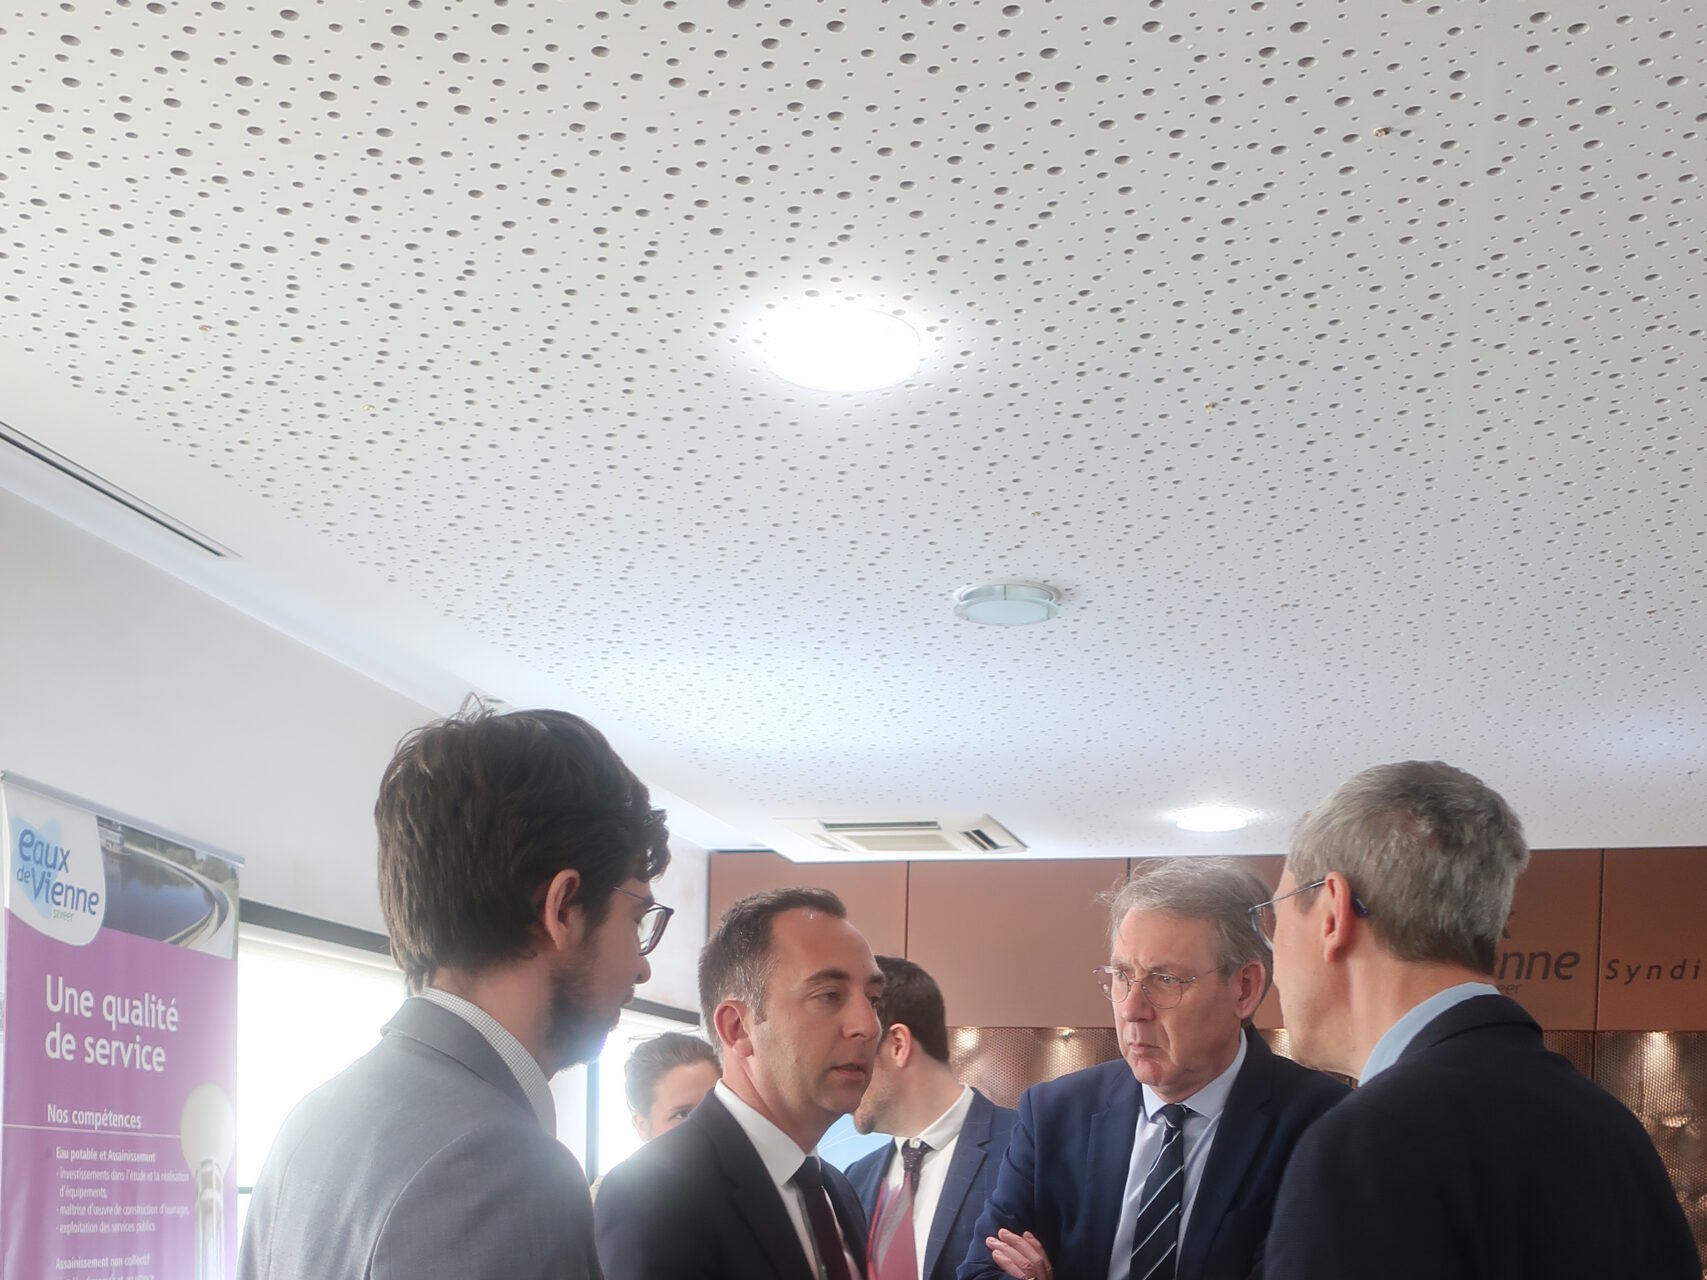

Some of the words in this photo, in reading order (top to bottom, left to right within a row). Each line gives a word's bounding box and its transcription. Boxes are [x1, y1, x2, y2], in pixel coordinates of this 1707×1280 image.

[19, 829, 70, 873] eaux
[17, 866, 31, 883] de
[32, 867, 99, 915] Vienne
[1498, 951, 1580, 980] nne
[46, 974, 94, 1018] Une
[102, 992, 179, 1032] qualité
[45, 1021, 76, 1061] de
[84, 1035, 166, 1072] service
[47, 1103, 68, 1124] Nos
[72, 1108, 142, 1130] compétences
[56, 1146, 68, 1159] Eau
[71, 1147, 97, 1162] potable
[99, 1151, 107, 1160] et
[108, 1149, 156, 1162] Assainissement
[111, 1169, 124, 1181] dans
[114, 1205, 122, 1215] de
[60, 1221, 98, 1235] exploitation
[99, 1222, 110, 1232] des
[111, 1222, 135, 1232] services
[56, 1256, 109, 1270] Assainissement
[110, 1258, 123, 1266] non
